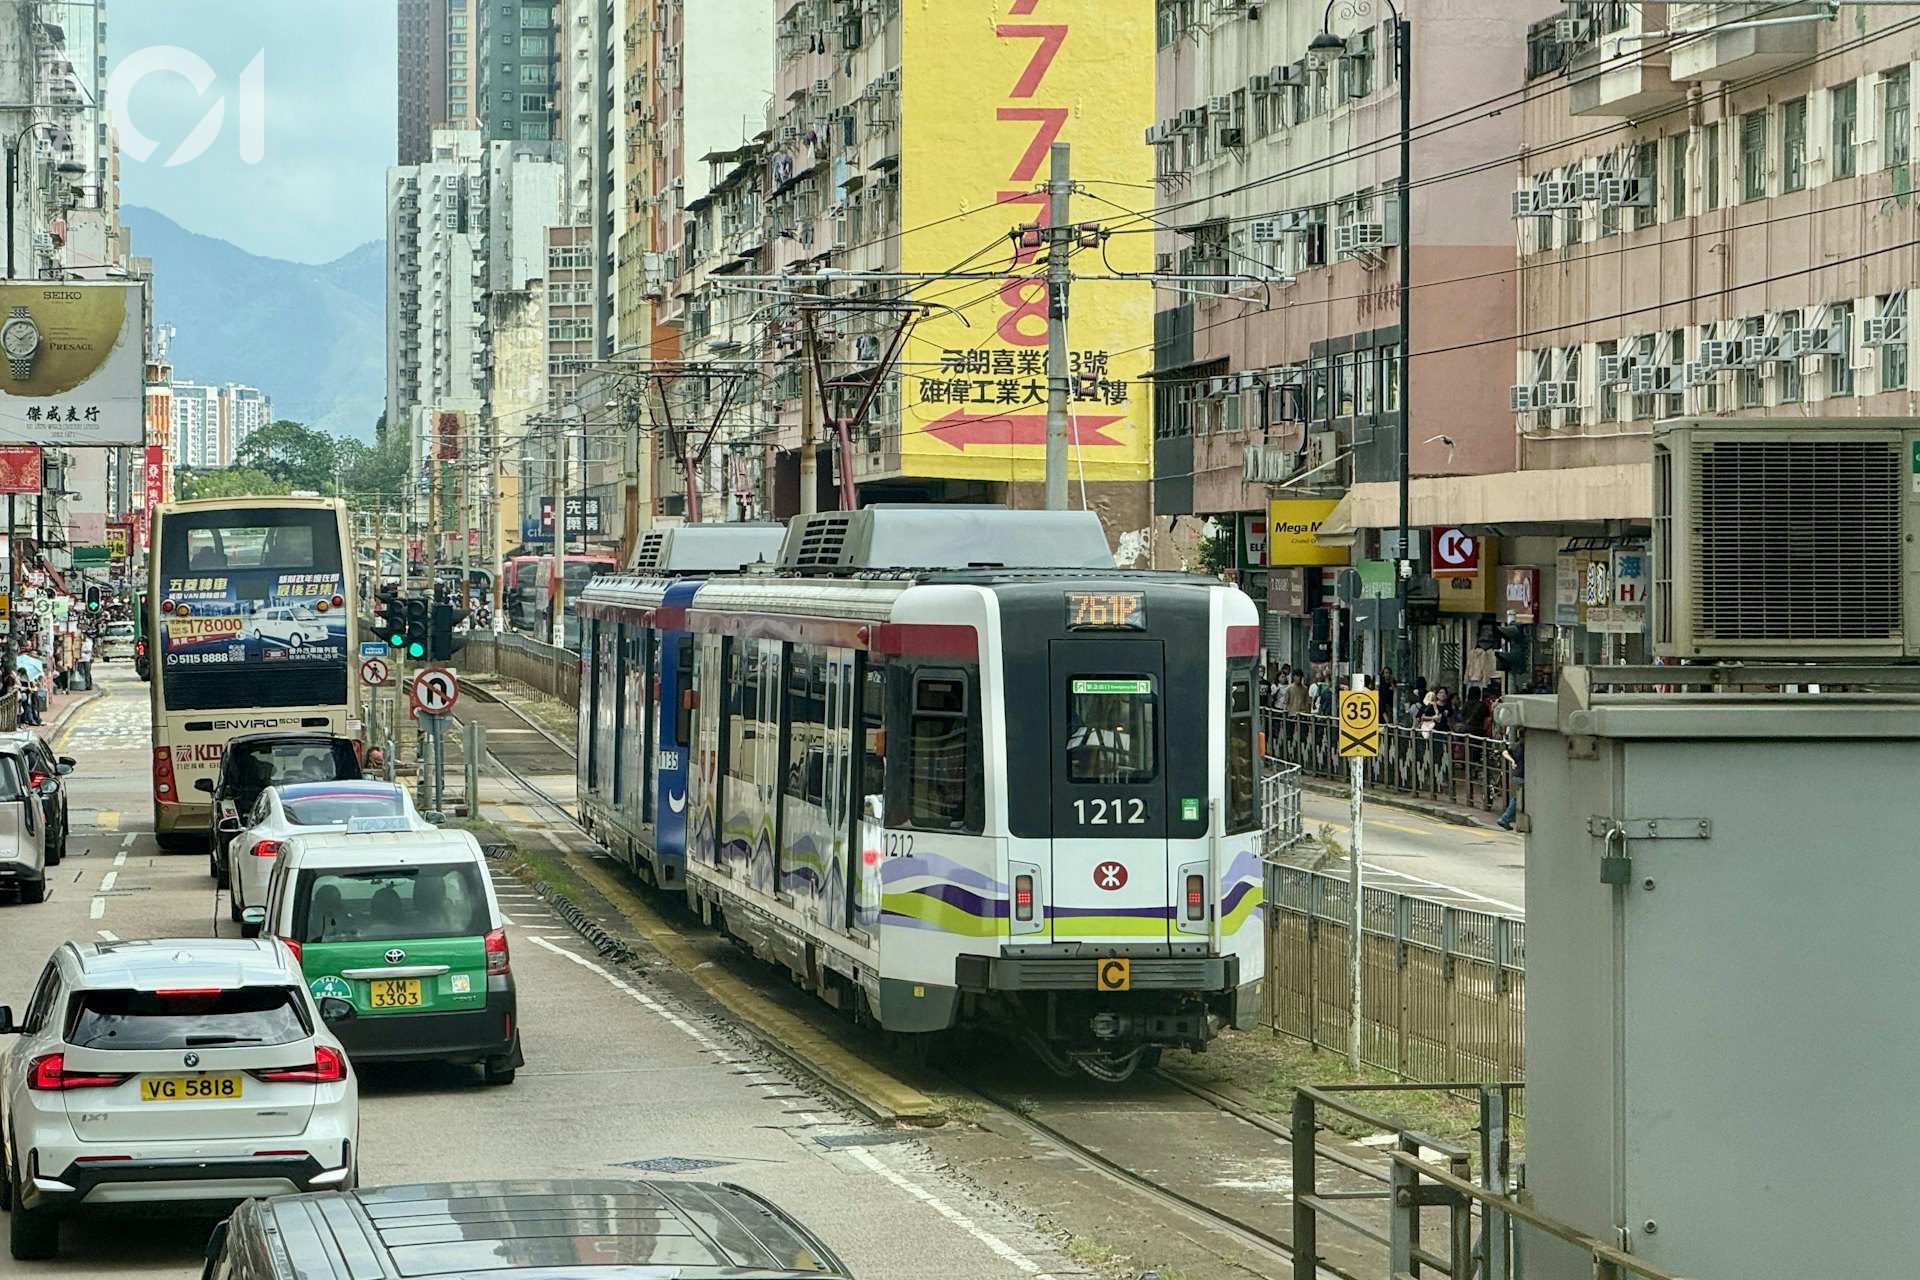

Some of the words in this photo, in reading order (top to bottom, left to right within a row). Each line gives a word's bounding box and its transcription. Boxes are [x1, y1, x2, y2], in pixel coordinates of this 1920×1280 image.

[996, 0, 1069, 347] 7778
[43, 291, 82, 300] SEIKO
[49, 342, 94, 351] PRESAGE
[920, 378, 1127, 405] 雄偉工業大11樓
[1275, 522, 1308, 534] Mega
[1071, 595, 1137, 625] 761P
[179, 654, 201, 664] 5115
[202, 653, 228, 663] 8888
[1346, 702, 1371, 720] 35
[214, 719, 278, 729] ENVIRO
[195, 744, 223, 761] KM
[659, 752, 678, 769] 1135
[1073, 798, 1146, 825] 1212
[353, 819, 405, 830] TAXI
[883, 834, 914, 859] 1212
[1101, 961, 1126, 988] C
[324, 983, 333, 991] 4
[386, 981, 407, 994] XM
[375, 993, 418, 1007] 3303
[148, 1081, 176, 1097] VG
[185, 1080, 234, 1096] 5818
